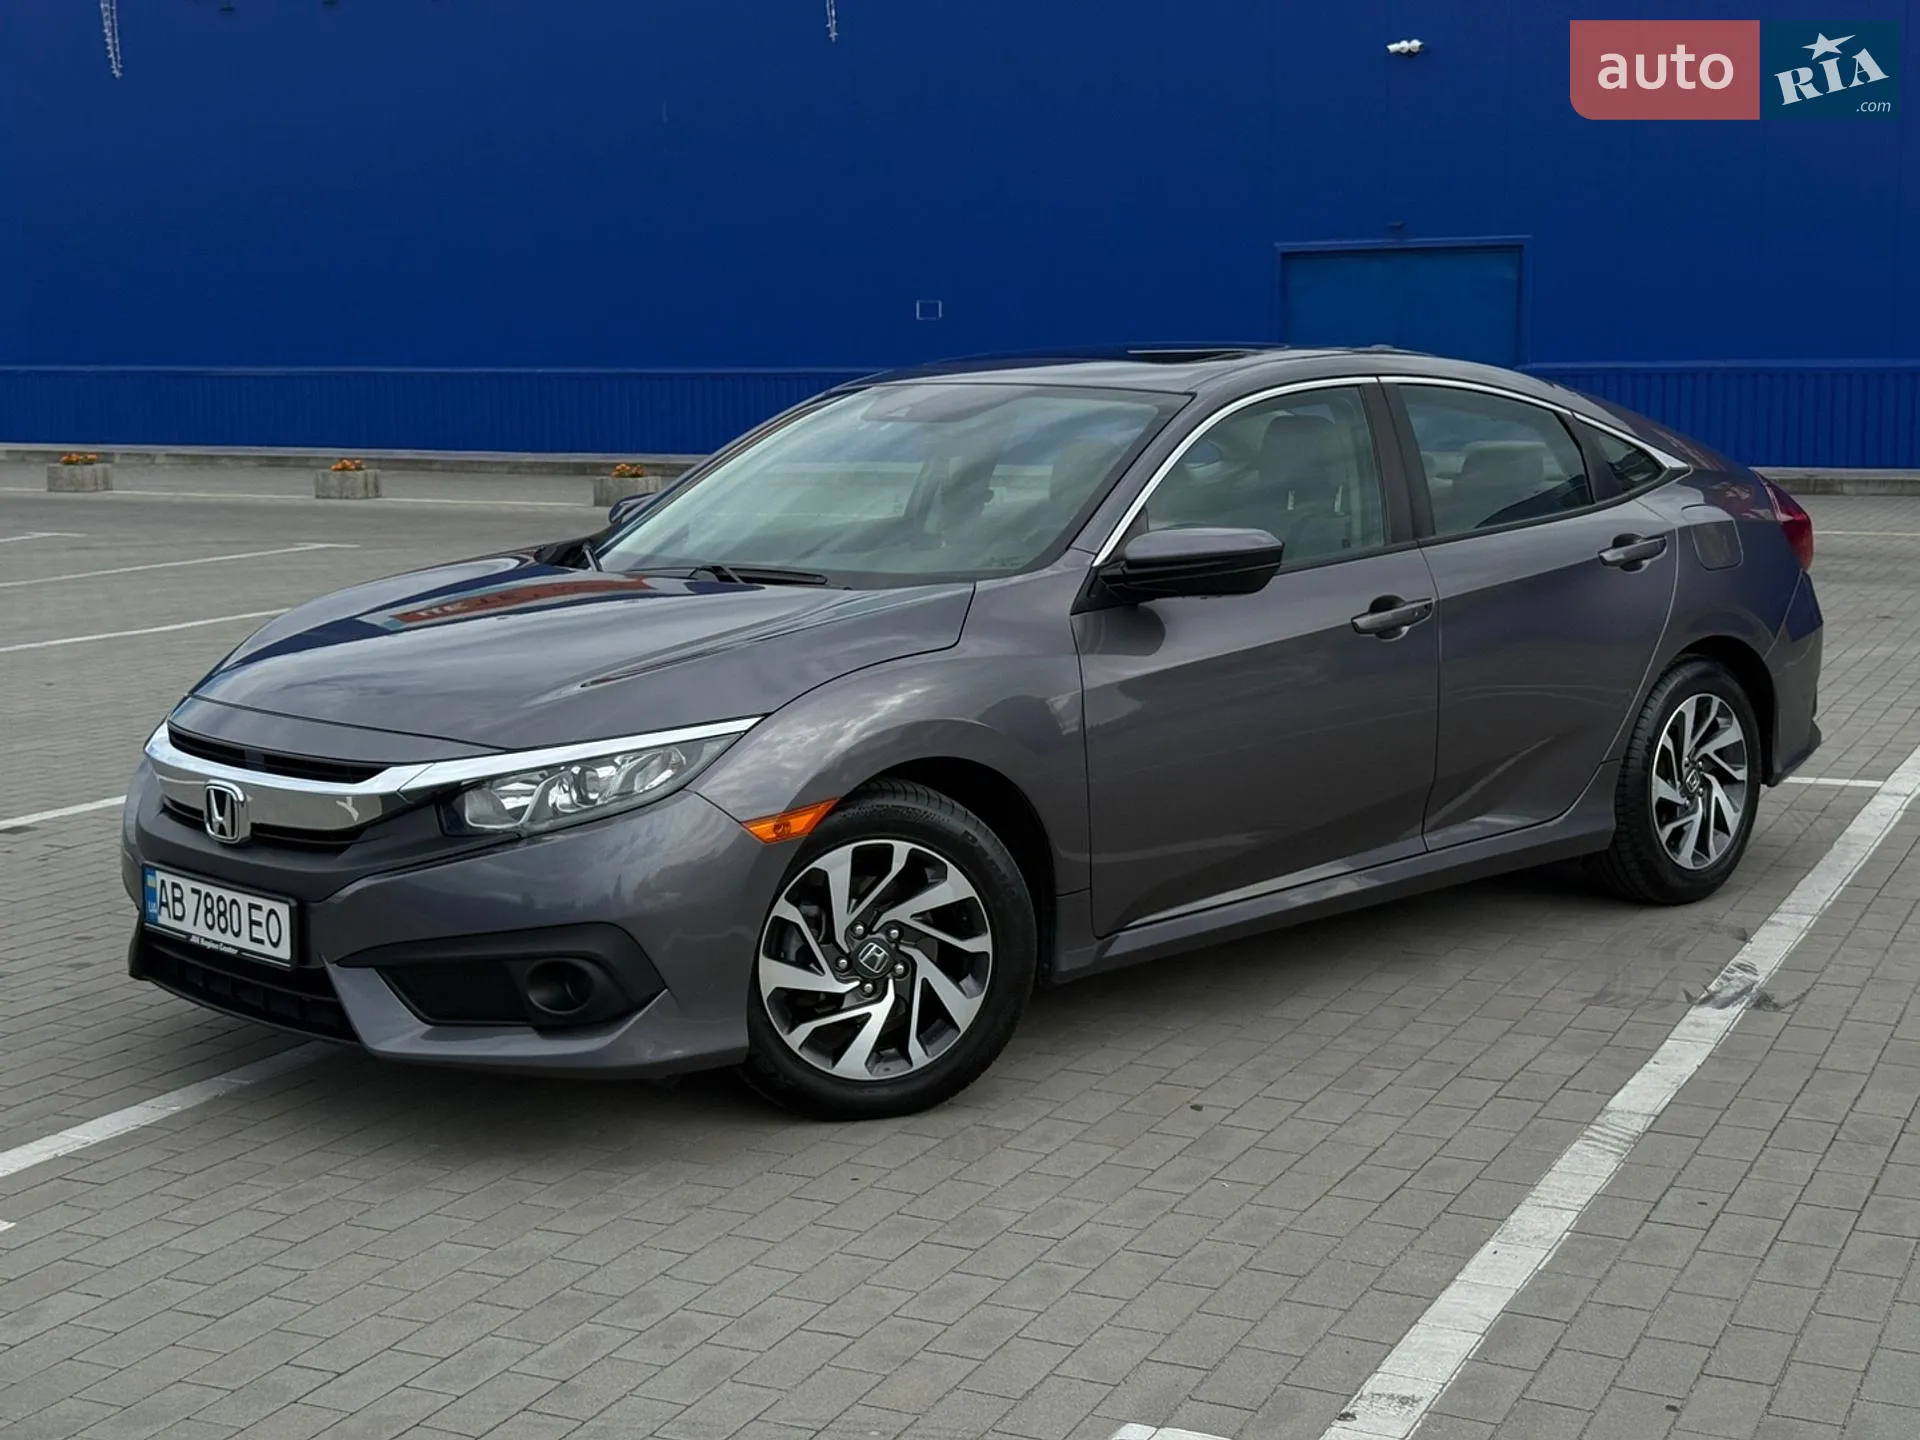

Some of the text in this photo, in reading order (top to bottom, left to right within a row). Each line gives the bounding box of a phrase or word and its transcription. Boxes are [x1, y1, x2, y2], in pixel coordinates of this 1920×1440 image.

[158, 878, 282, 949] AB 7880 EO
